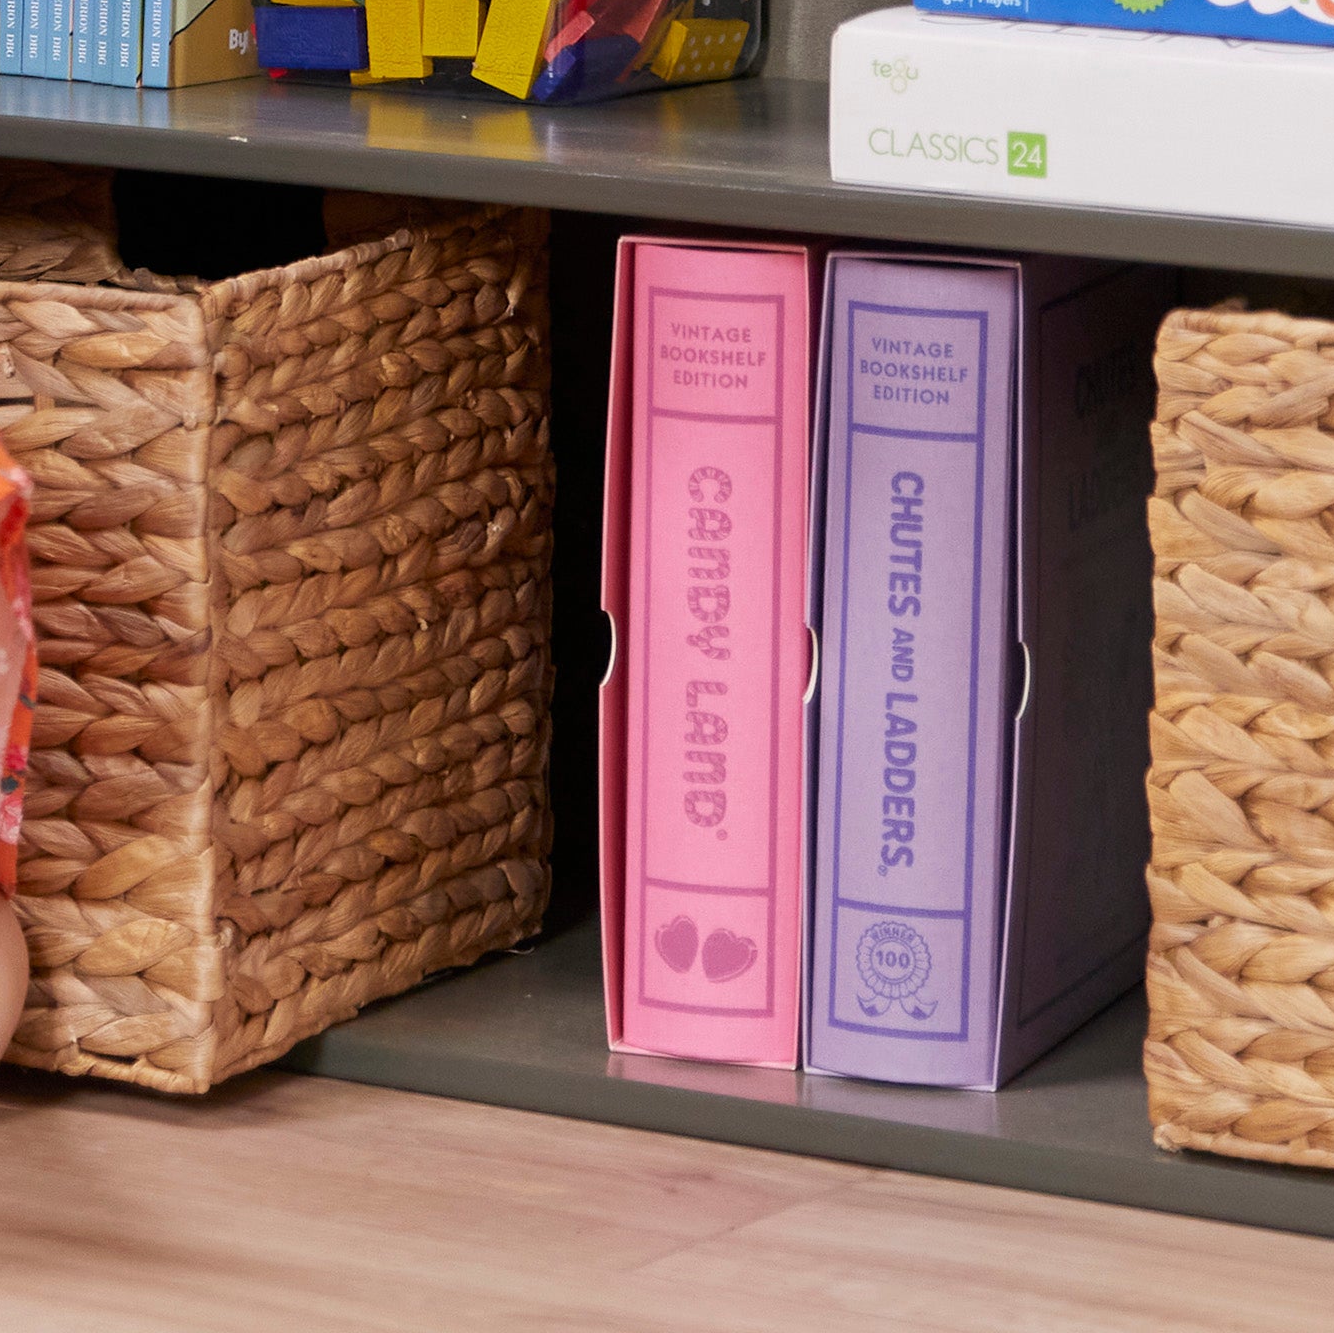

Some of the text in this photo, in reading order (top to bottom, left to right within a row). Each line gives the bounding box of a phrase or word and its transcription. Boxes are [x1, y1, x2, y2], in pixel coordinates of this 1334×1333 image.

[229, 28, 249, 55] By
[871, 56, 919, 94] tegu
[868, 128, 1043, 169] CLASSICS 24
[671, 323, 751, 343] VINTAGE
[660, 345, 766, 366] BOOKSHELF
[872, 338, 953, 358] VINTAGE
[673, 370, 748, 389] EDITION
[860, 359, 968, 382] BOOKSHELF
[874, 385, 949, 404] EDITION
[888, 471, 925, 617] CHUTES
[683, 466, 732, 828] CANDY LAND
[891, 627, 914, 681] AND
[876, 951, 910, 969] 100
